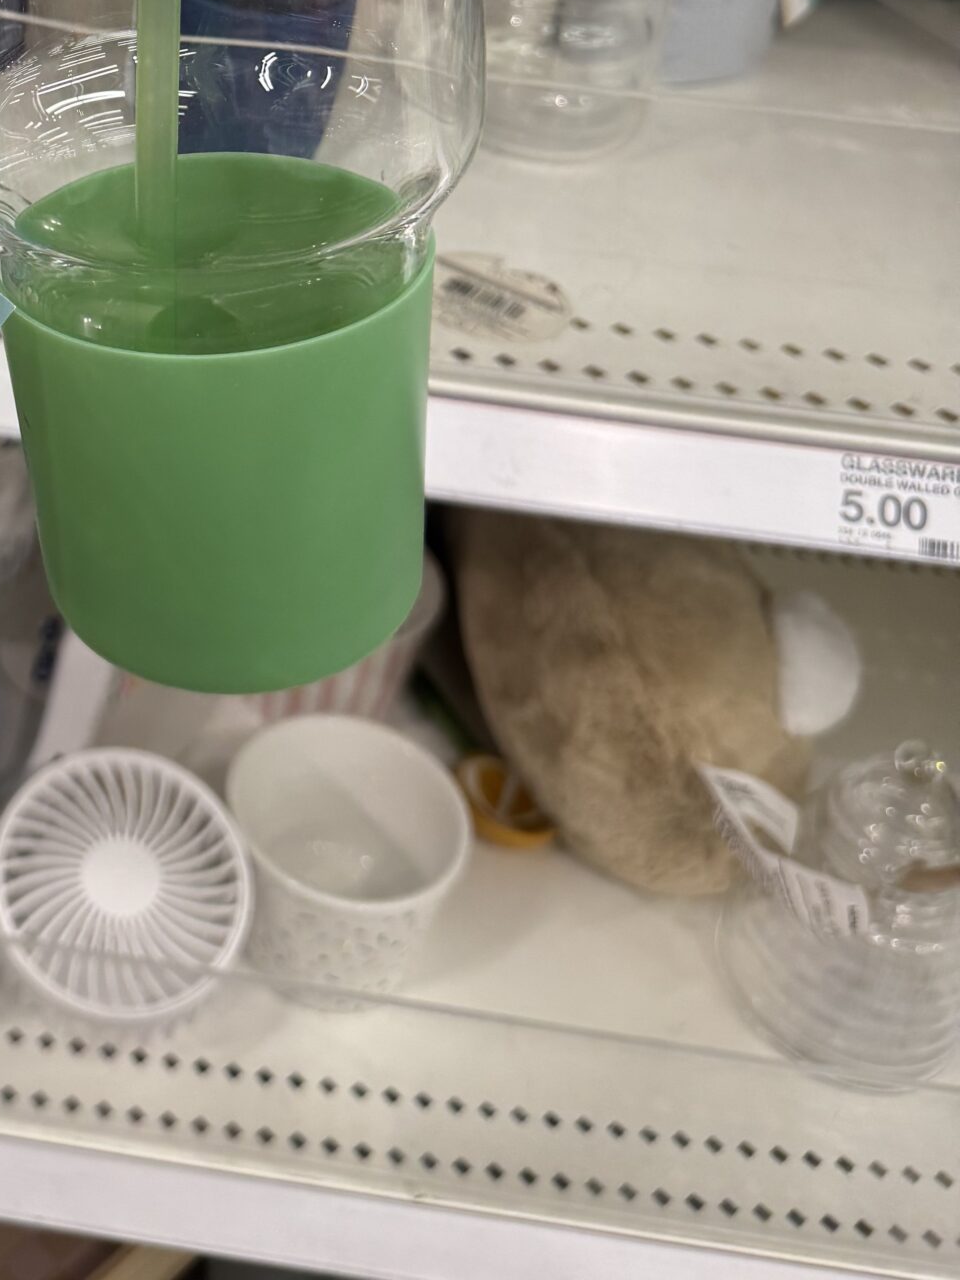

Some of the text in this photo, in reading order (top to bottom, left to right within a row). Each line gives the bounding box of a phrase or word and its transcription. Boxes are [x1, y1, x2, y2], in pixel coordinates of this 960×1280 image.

[840, 471, 894, 490] DOUBLE
[896, 480, 951, 496] WALLED
[840, 489, 928, 531] 5.00
